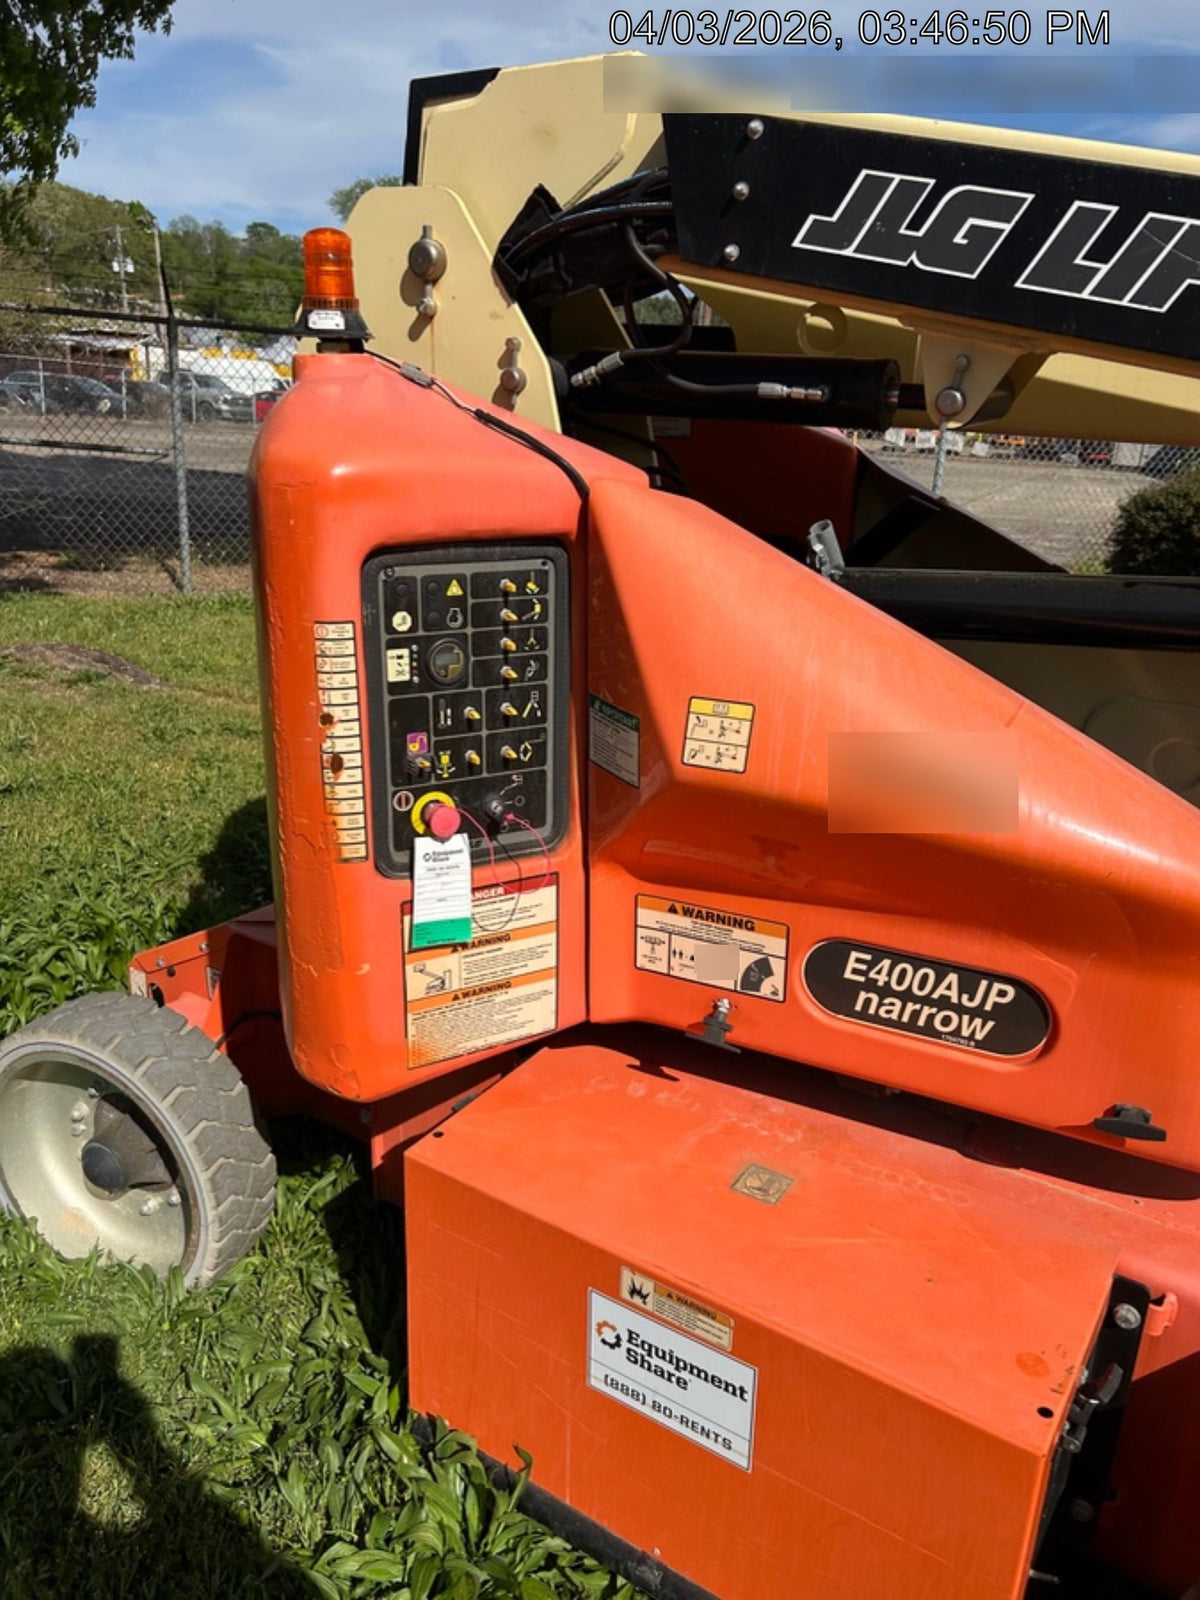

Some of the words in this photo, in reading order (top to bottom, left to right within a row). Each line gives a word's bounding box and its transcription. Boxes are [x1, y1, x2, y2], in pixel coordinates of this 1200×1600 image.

[791, 168, 1036, 280] JLG
[681, 904, 755, 931] WARNING
[461, 980, 512, 999] WARNING
[843, 950, 1016, 1012] E400AJP
[854, 989, 996, 1041] narrow
[625, 1346, 689, 1391] Share
[626, 1328, 749, 1402] Equipment
[603, 1373, 647, 1406] (888)
[651, 1399, 733, 1451] 80-RENTS
